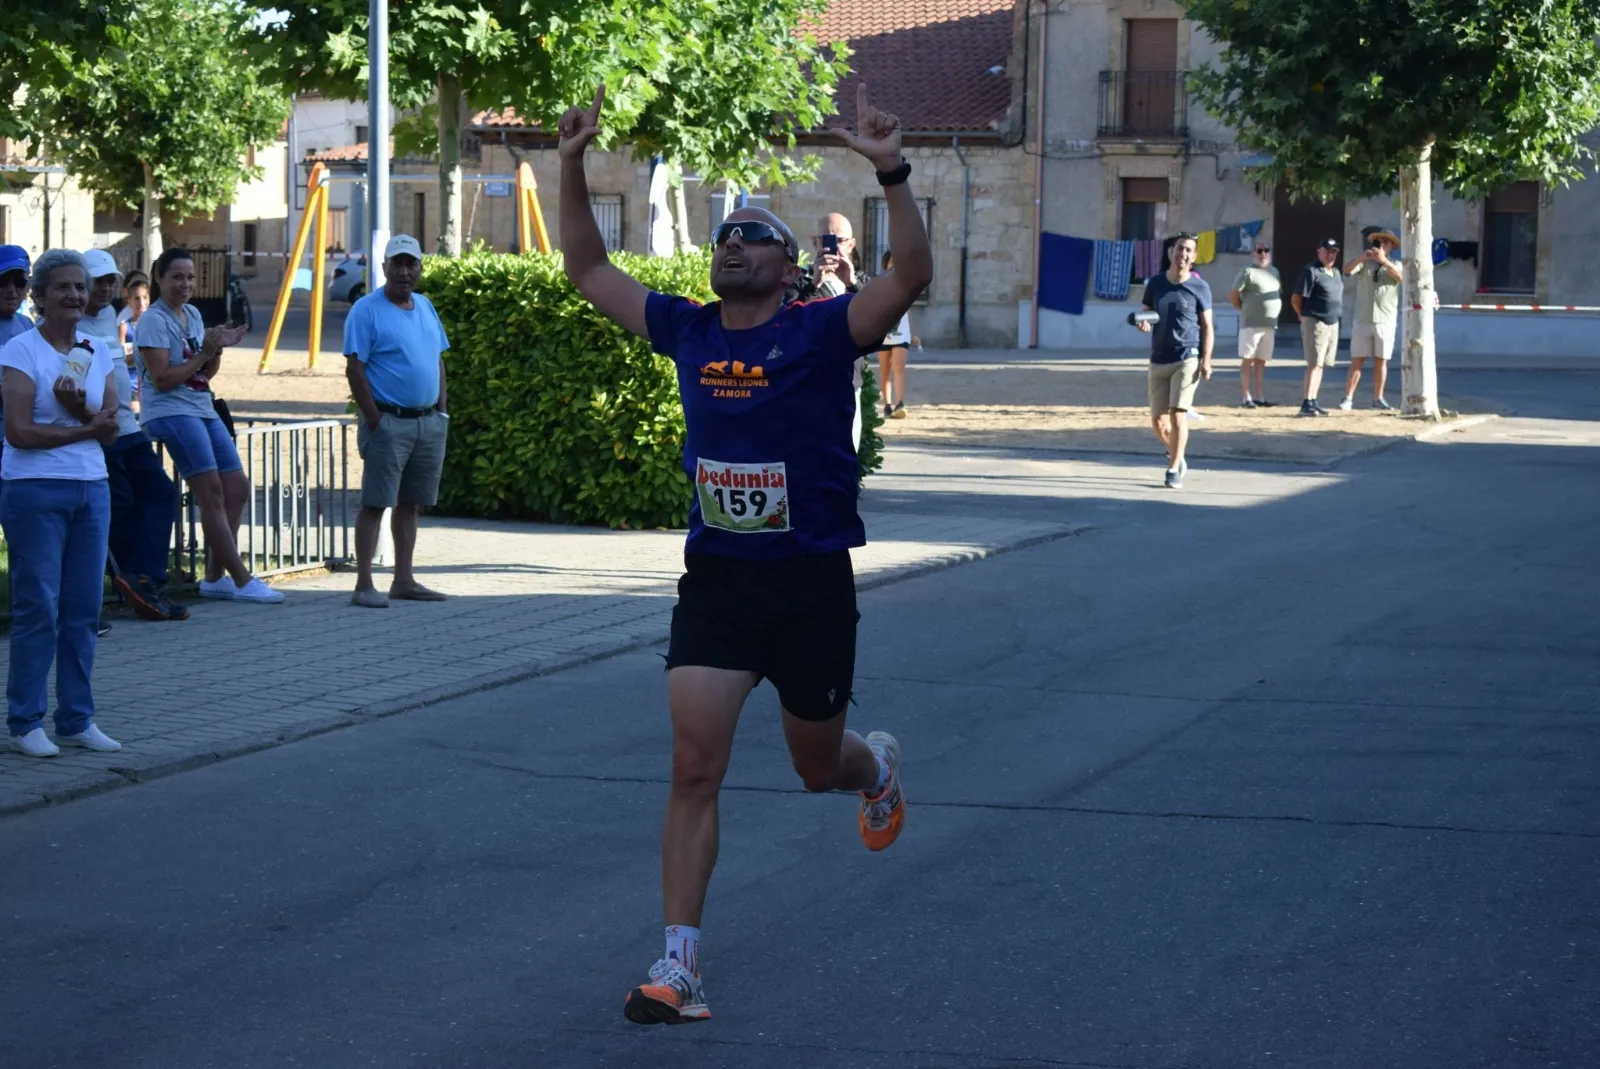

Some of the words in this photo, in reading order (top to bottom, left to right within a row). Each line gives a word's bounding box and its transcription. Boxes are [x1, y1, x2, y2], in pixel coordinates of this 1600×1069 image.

[700, 378, 737, 387] RUNNERS
[740, 379, 769, 387] LEONES
[713, 389, 751, 398] ZAMORA
[698, 464, 785, 488] bedunia
[713, 488, 768, 517] 159
